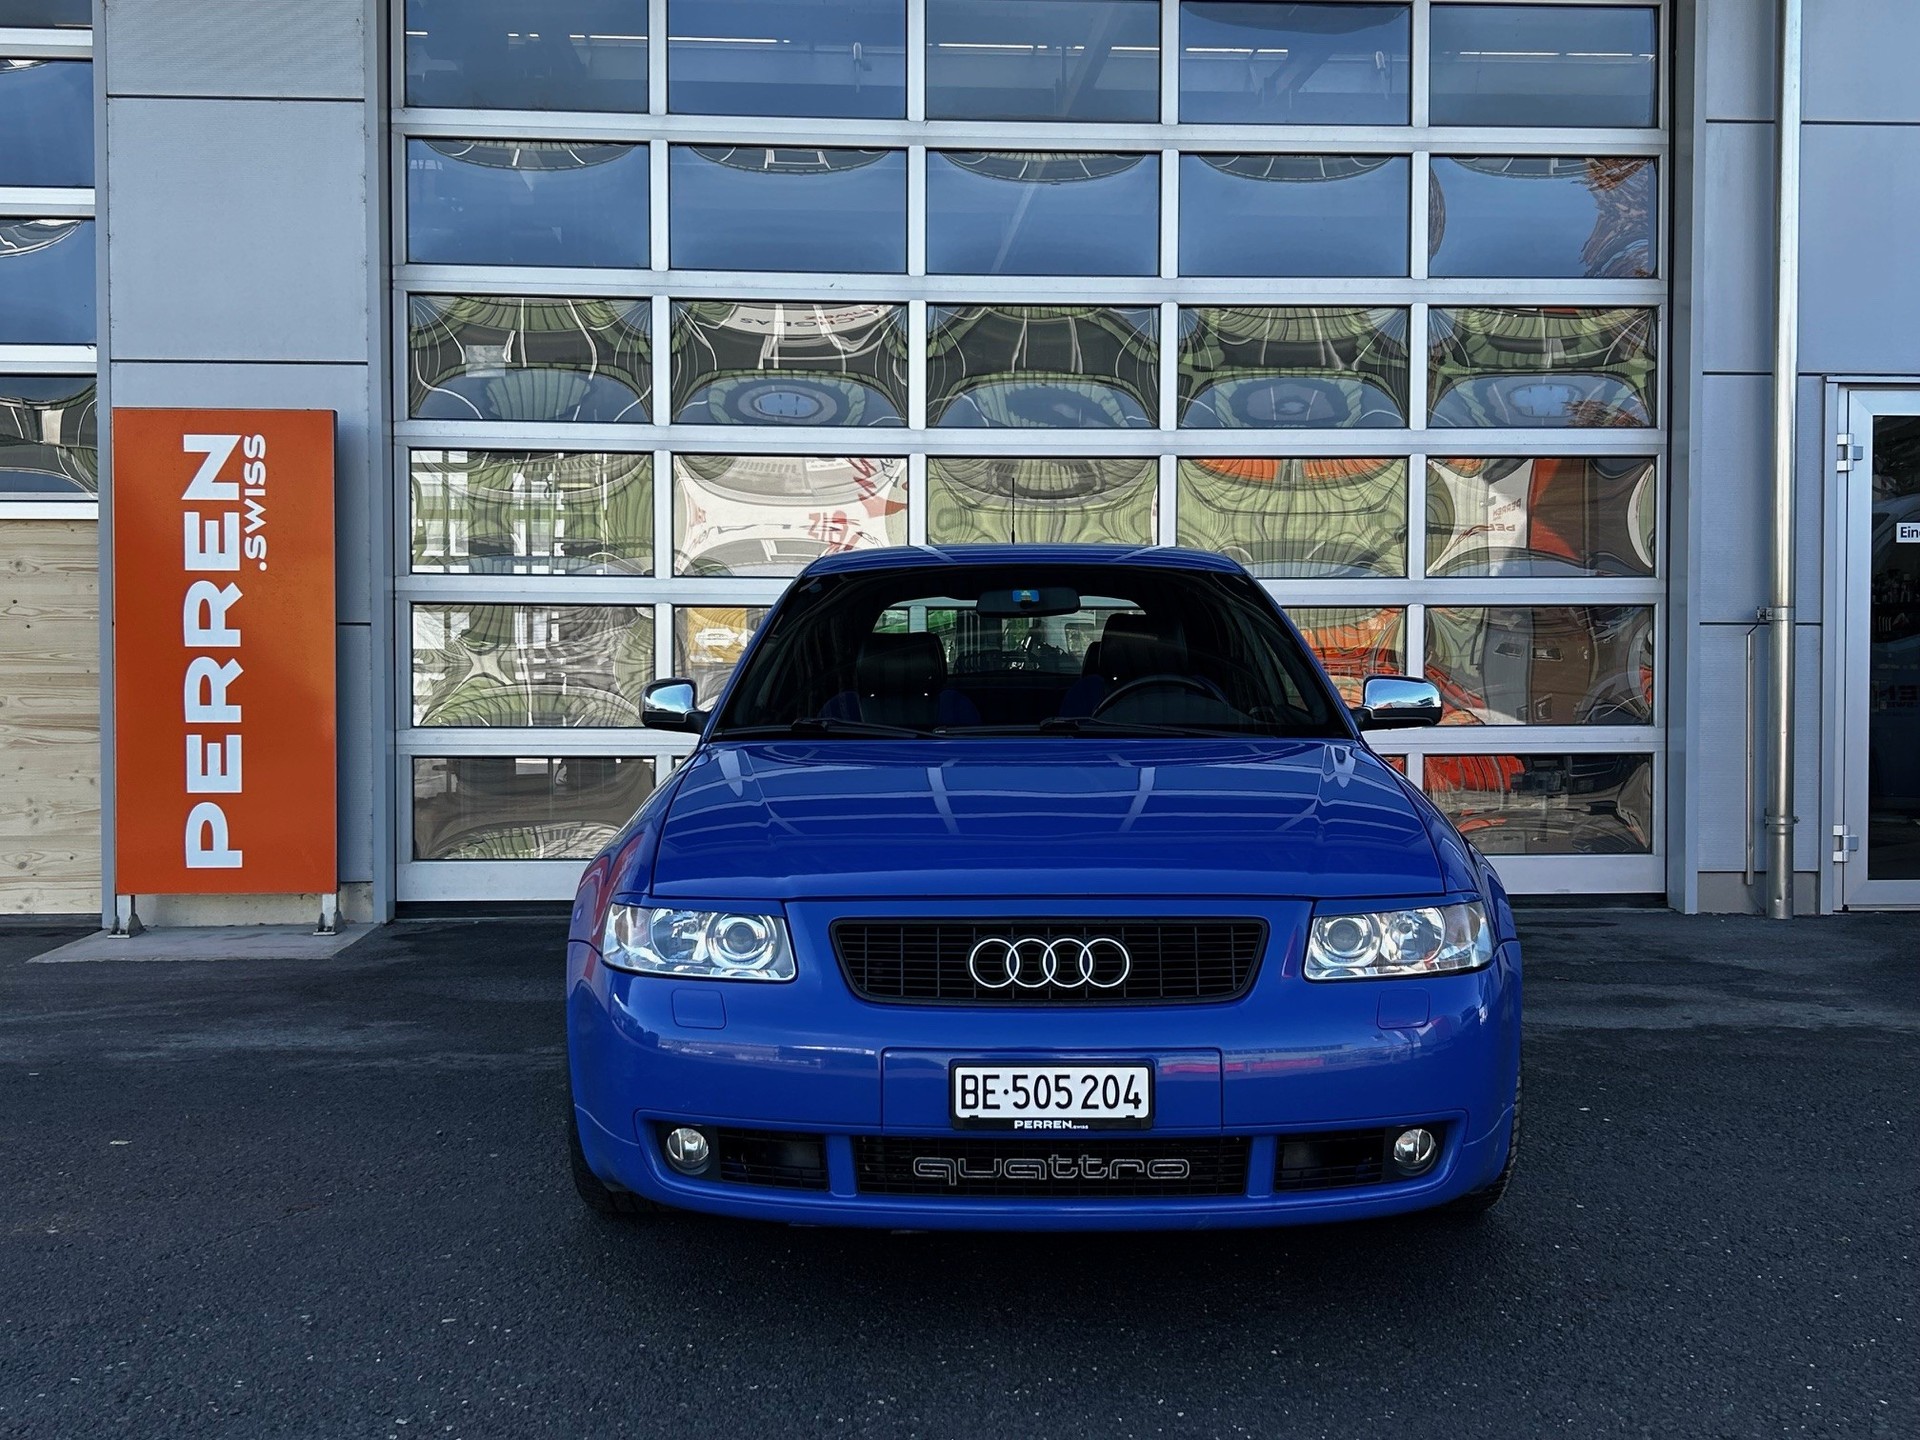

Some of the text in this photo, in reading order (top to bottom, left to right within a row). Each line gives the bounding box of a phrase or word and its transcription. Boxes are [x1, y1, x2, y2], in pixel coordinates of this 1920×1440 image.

[1900, 526, 1920, 538] Ein
[181, 434, 244, 869] PERREN
[913, 1154, 1190, 1186] quattro
